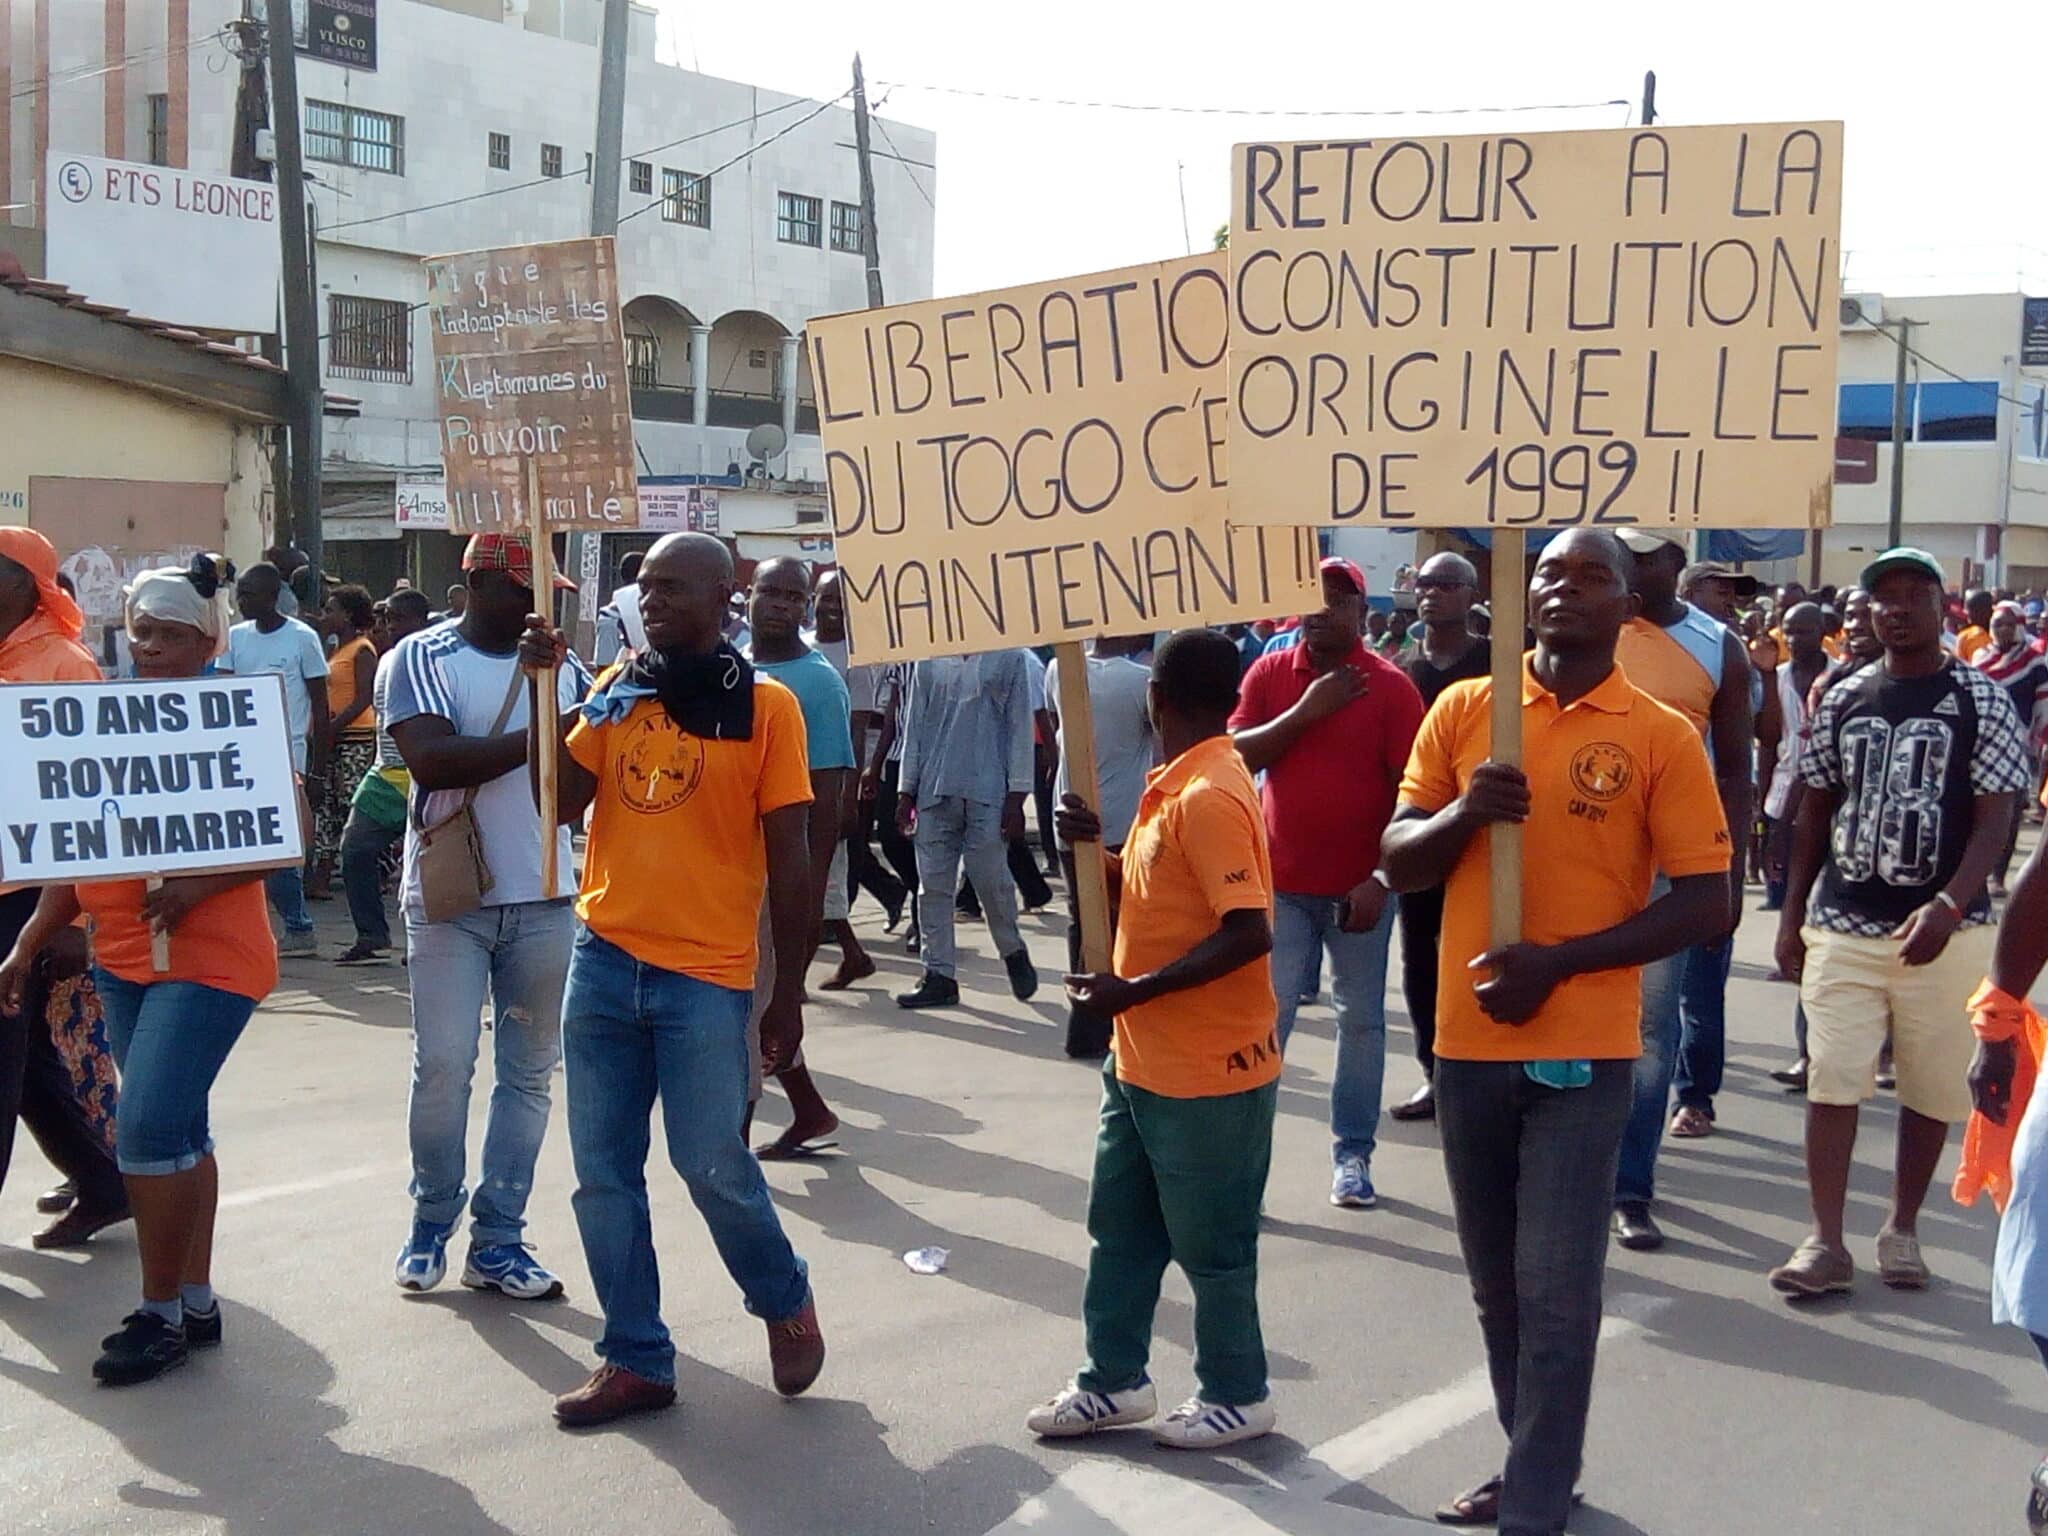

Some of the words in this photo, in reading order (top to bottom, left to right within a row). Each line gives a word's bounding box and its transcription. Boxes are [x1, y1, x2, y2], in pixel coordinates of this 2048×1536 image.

[320, 29, 366, 50] VLISCO
[105, 167, 161, 206] ETS
[174, 177, 274, 222] LEONCE
[1246, 138, 1537, 232] RETOUR
[1625, 132, 1669, 217] A
[1732, 129, 1822, 217] LA
[1236, 236, 1826, 336] CONSTITUTION
[440, 356, 576, 409] Kleptomanes
[581, 361, 607, 391] du
[1238, 345, 1822, 441] ORIGINELLE
[446, 415, 566, 456] Pouvoir
[825, 440, 906, 538] DU
[917, 418, 1124, 530] TOGO
[1331, 452, 1419, 520] DE
[1464, 441, 1639, 525] 1992
[20, 696, 84, 739] 50
[96, 692, 189, 736] ANS
[199, 688, 257, 730] DE
[37, 742, 255, 800] ROYAUTÉ,
[8, 823, 38, 864] Y
[50, 818, 108, 862] EN
[120, 806, 284, 857] MARRE
